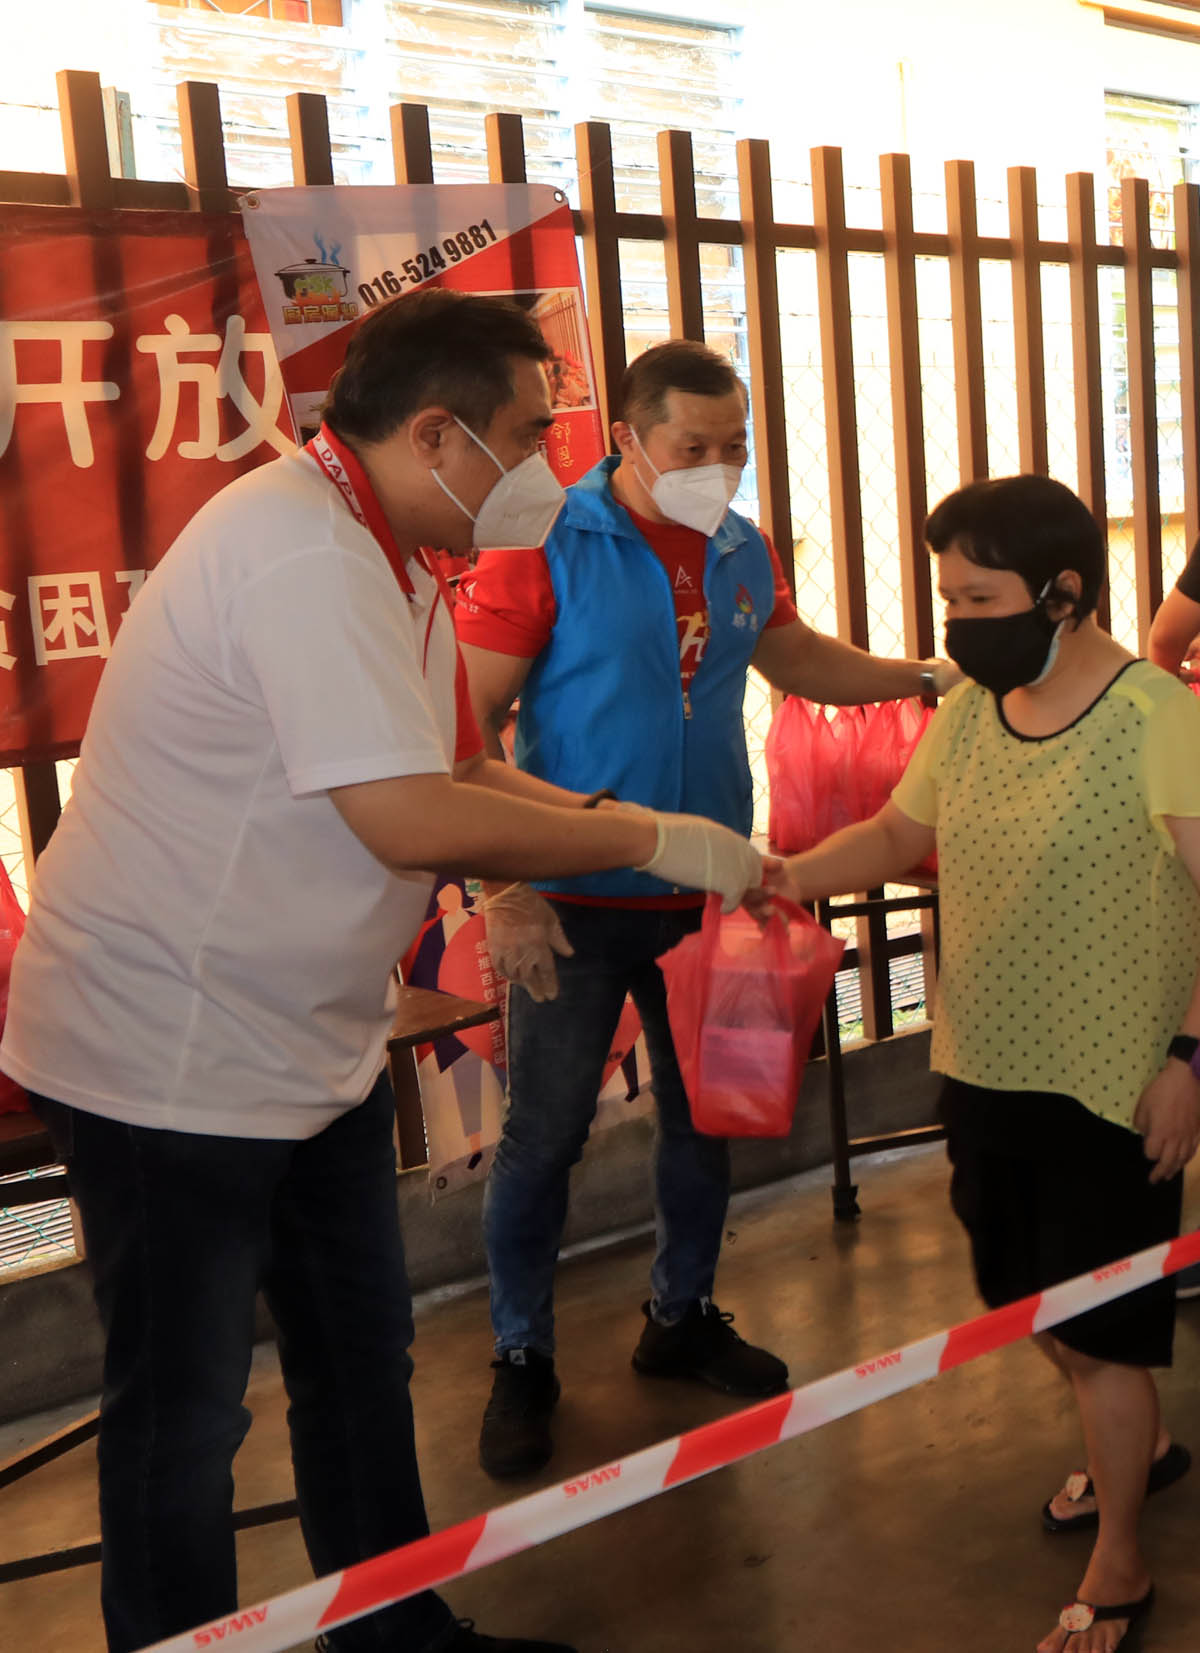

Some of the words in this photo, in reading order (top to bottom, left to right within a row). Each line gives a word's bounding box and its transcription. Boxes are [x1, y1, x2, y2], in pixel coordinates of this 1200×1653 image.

[357, 246, 446, 308] 016-524
[442, 218, 498, 264] 9881
[320, 449, 353, 498] DAP
[563, 1463, 621, 1498] AWAS
[193, 1604, 268, 1649] AWAS
